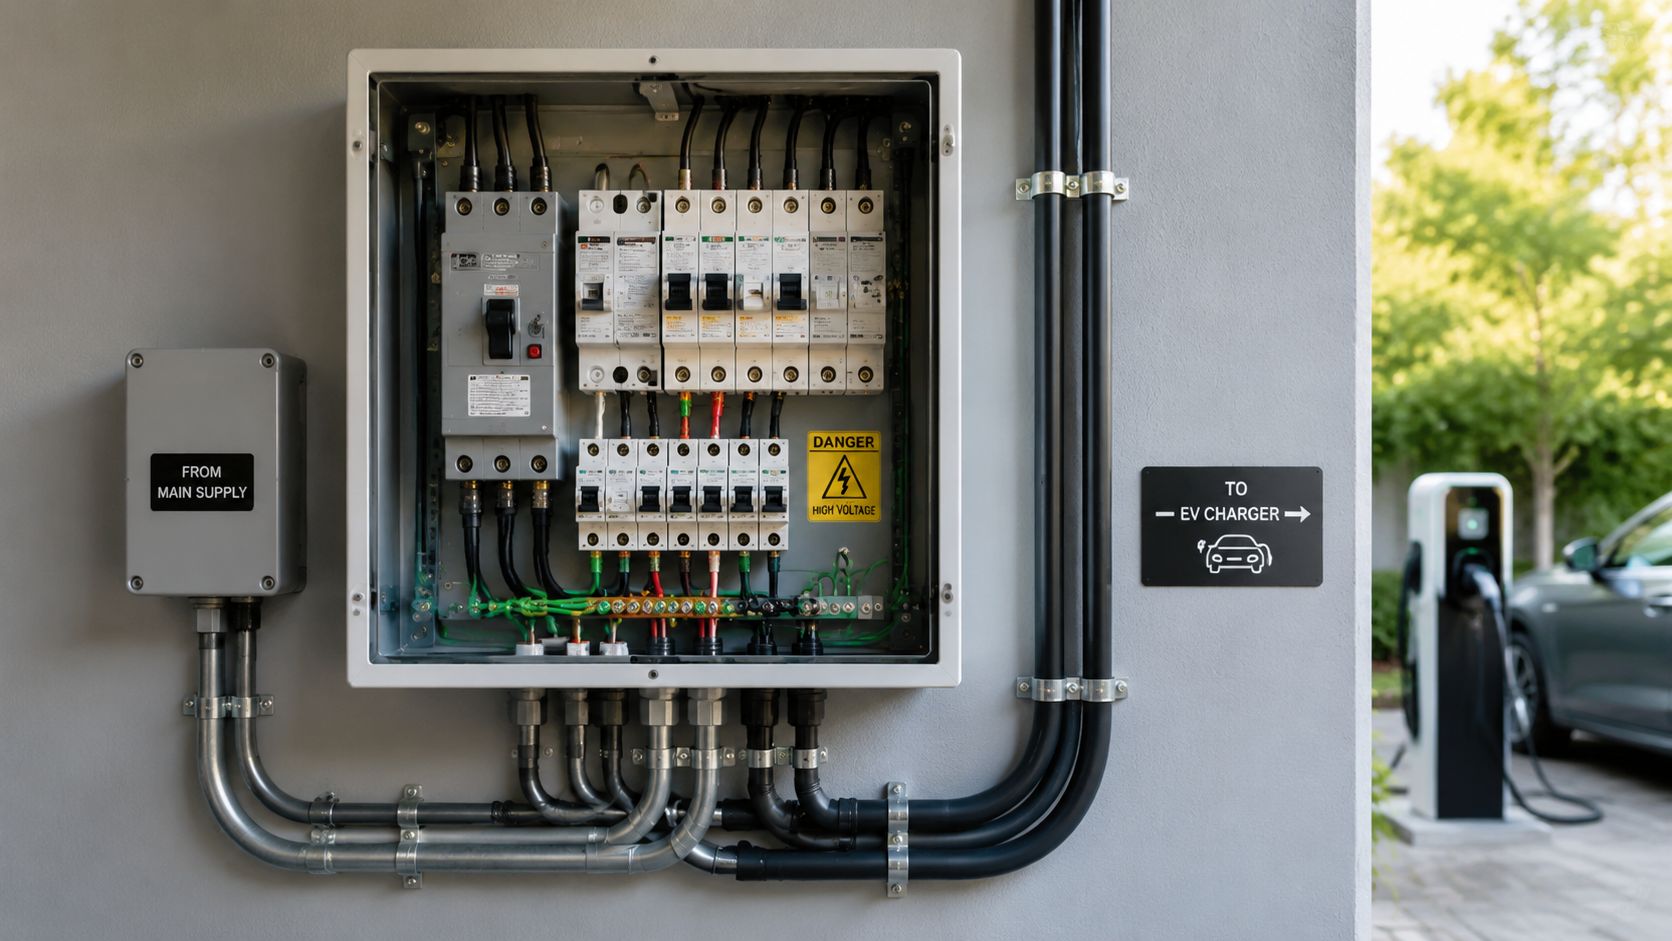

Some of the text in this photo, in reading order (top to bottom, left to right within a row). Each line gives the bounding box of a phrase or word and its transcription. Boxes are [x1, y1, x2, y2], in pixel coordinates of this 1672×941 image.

[813, 436, 874, 448] DANGER
[182, 465, 222, 478] FROM
[157, 486, 248, 499] MAIN SUPPLY
[1225, 481, 1248, 496] TO
[812, 504, 876, 515] HIGH VOLTAGE
[1180, 506, 1280, 521] EV CHARGER
